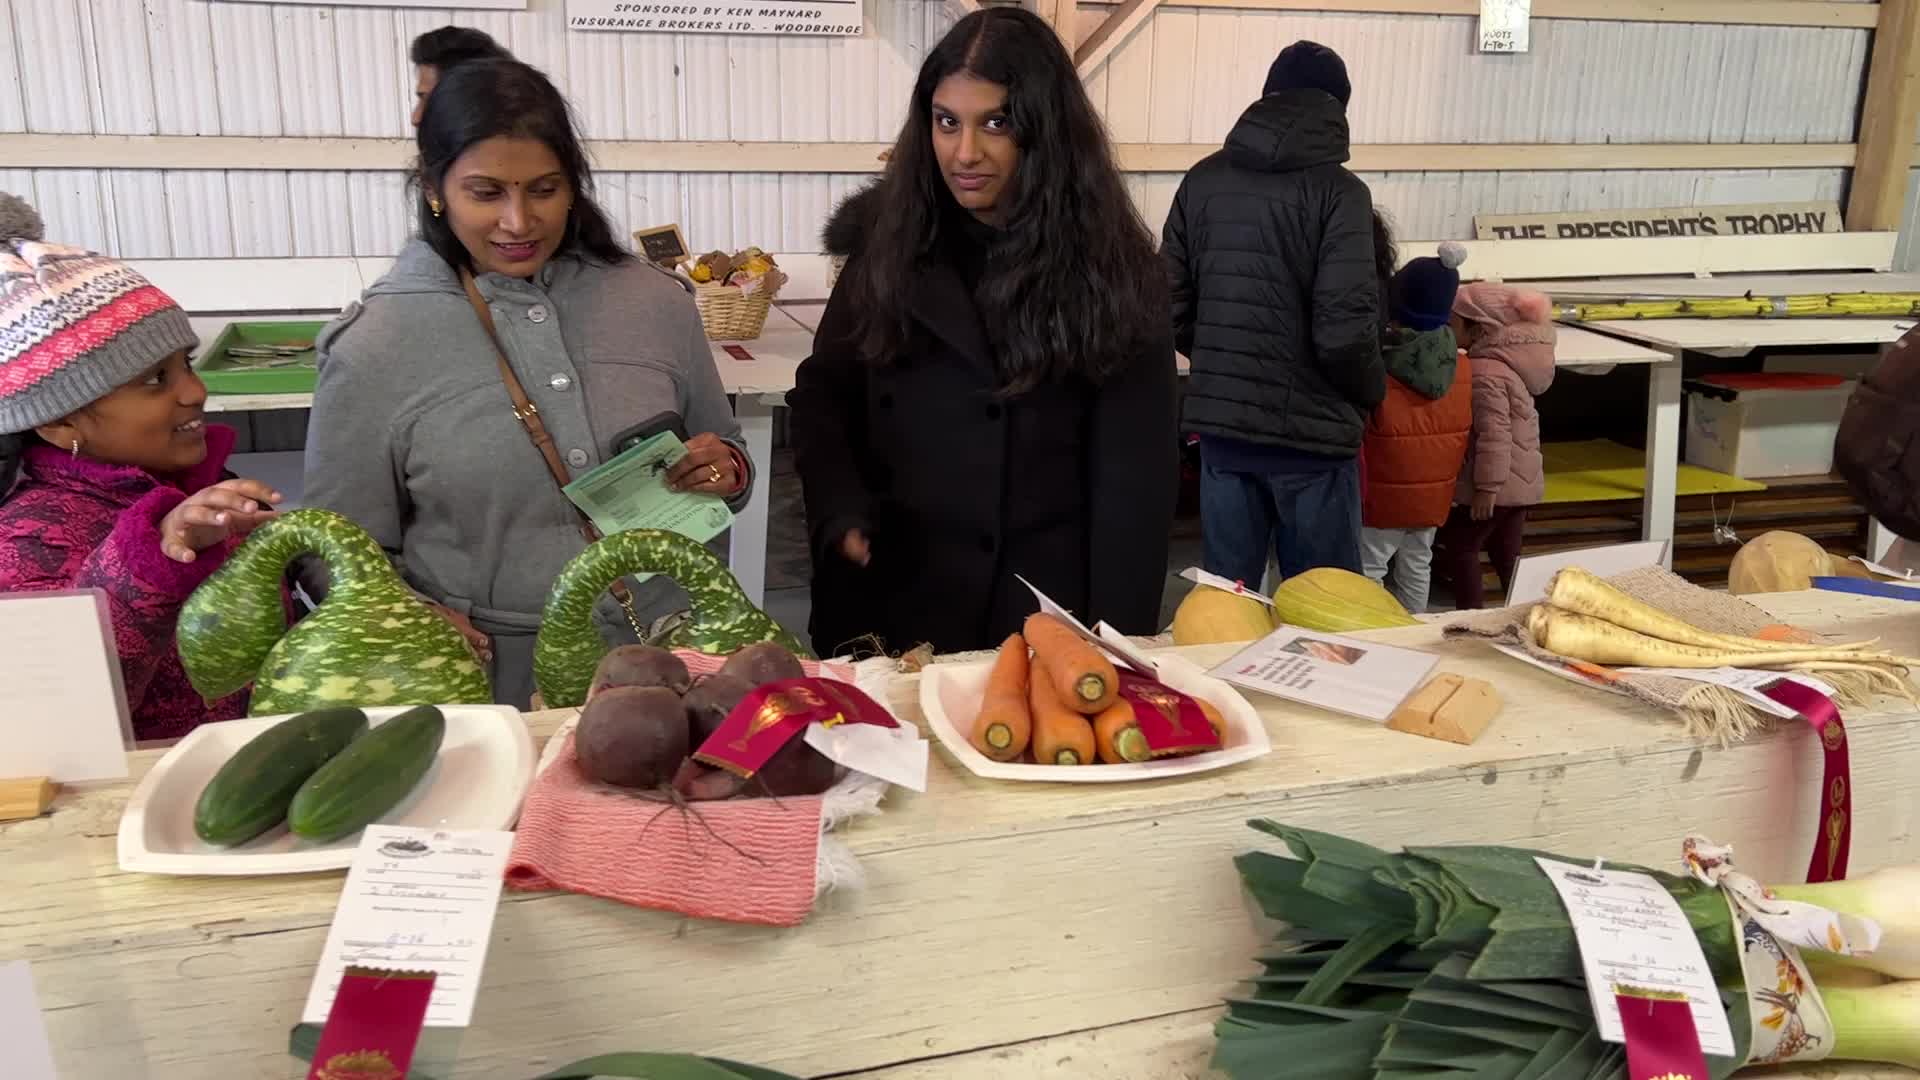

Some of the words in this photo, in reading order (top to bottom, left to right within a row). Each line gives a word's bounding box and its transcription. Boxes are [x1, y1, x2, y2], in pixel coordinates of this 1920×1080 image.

[614, 4, 697, 14] SPONSORED
[703, 7, 721, 15] BY
[727, 8, 753, 16] KEN
[758, 9, 822, 18] MAYNARD
[571, 17, 653, 27] INSURANCE
[658, 20, 722, 29] BROKERS
[728, 22, 755, 30] LTD.
[774, 23, 861, 34] WOODBRIDGE
[1492, 225, 1546, 239] THE
[1557, 212, 1718, 238] PRESIDENT'S
[1726, 212, 1826, 235] TROPHY
